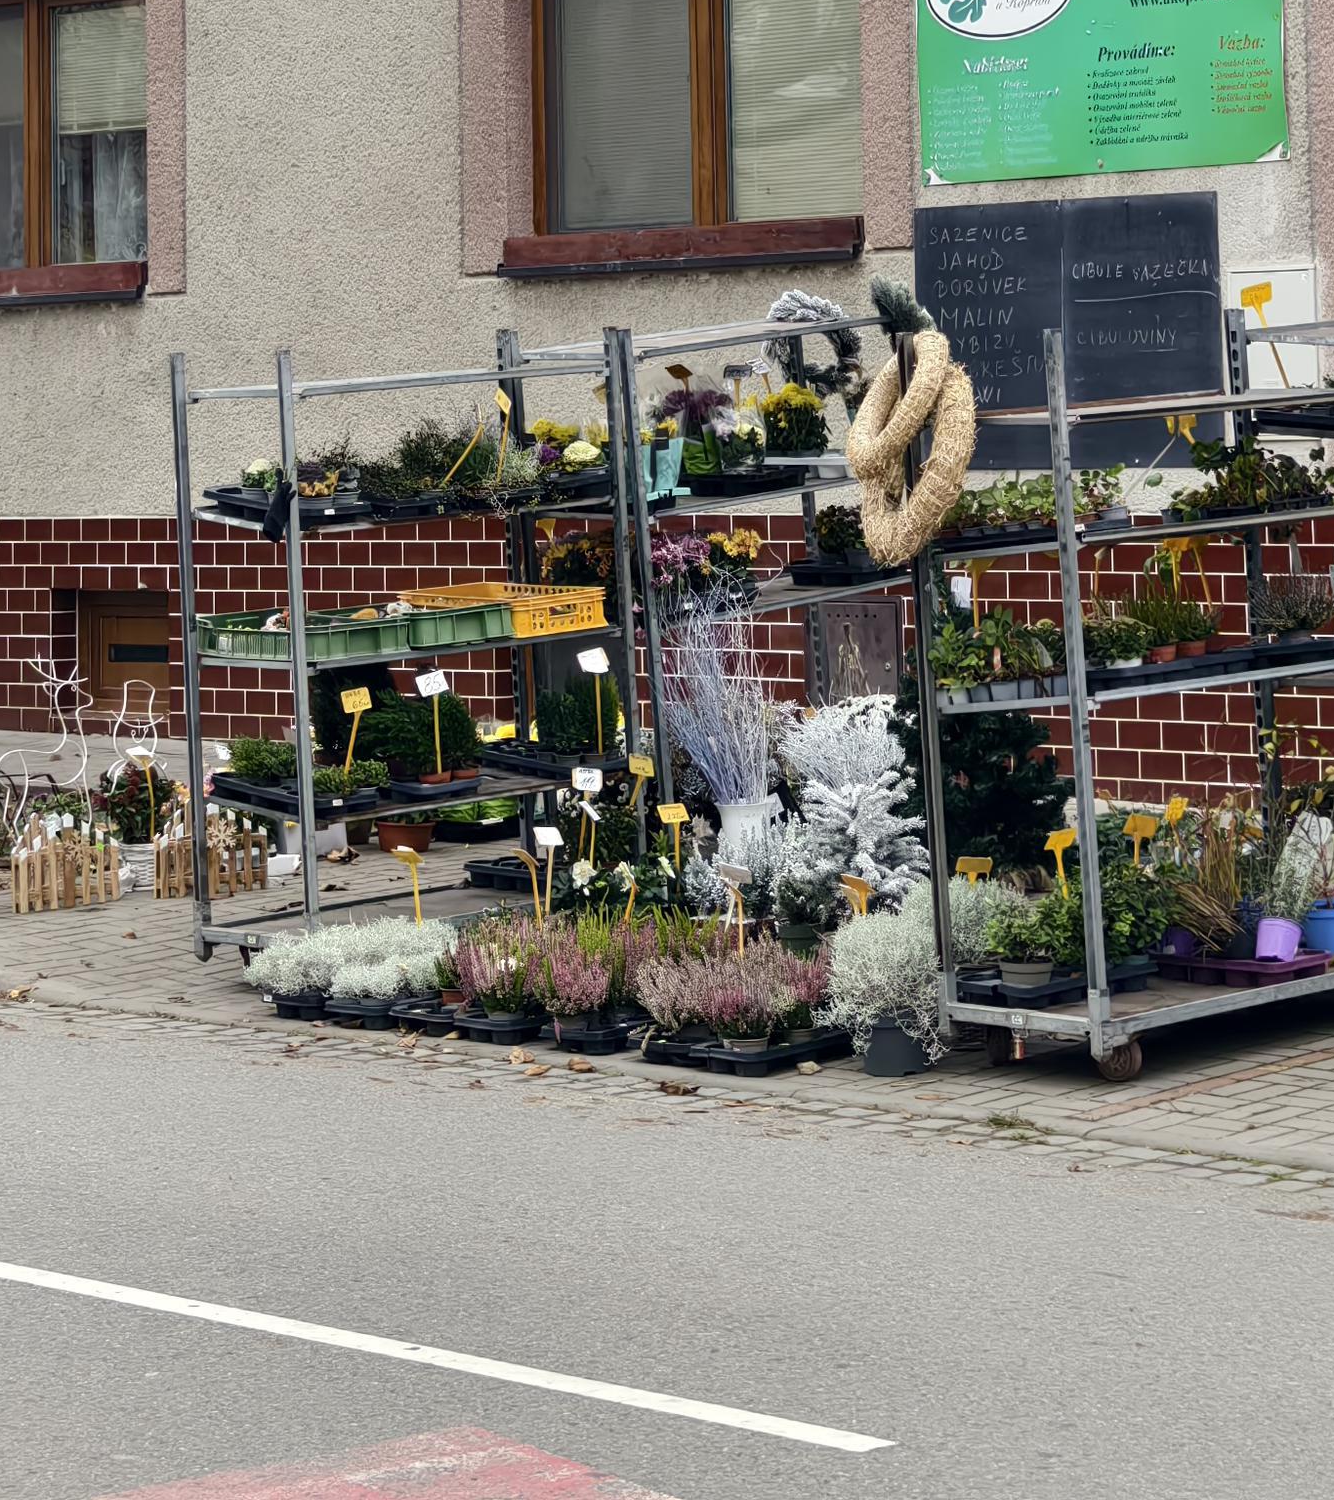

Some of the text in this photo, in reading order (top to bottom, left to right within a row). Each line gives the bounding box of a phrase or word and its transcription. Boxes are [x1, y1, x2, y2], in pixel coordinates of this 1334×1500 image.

[1098, 42, 1175, 62] Provádíme:
[929, 226, 1027, 245] SAZENICE
[1072, 261, 1124, 280] CIBULE
[940, 306, 1014, 330] MALIN
